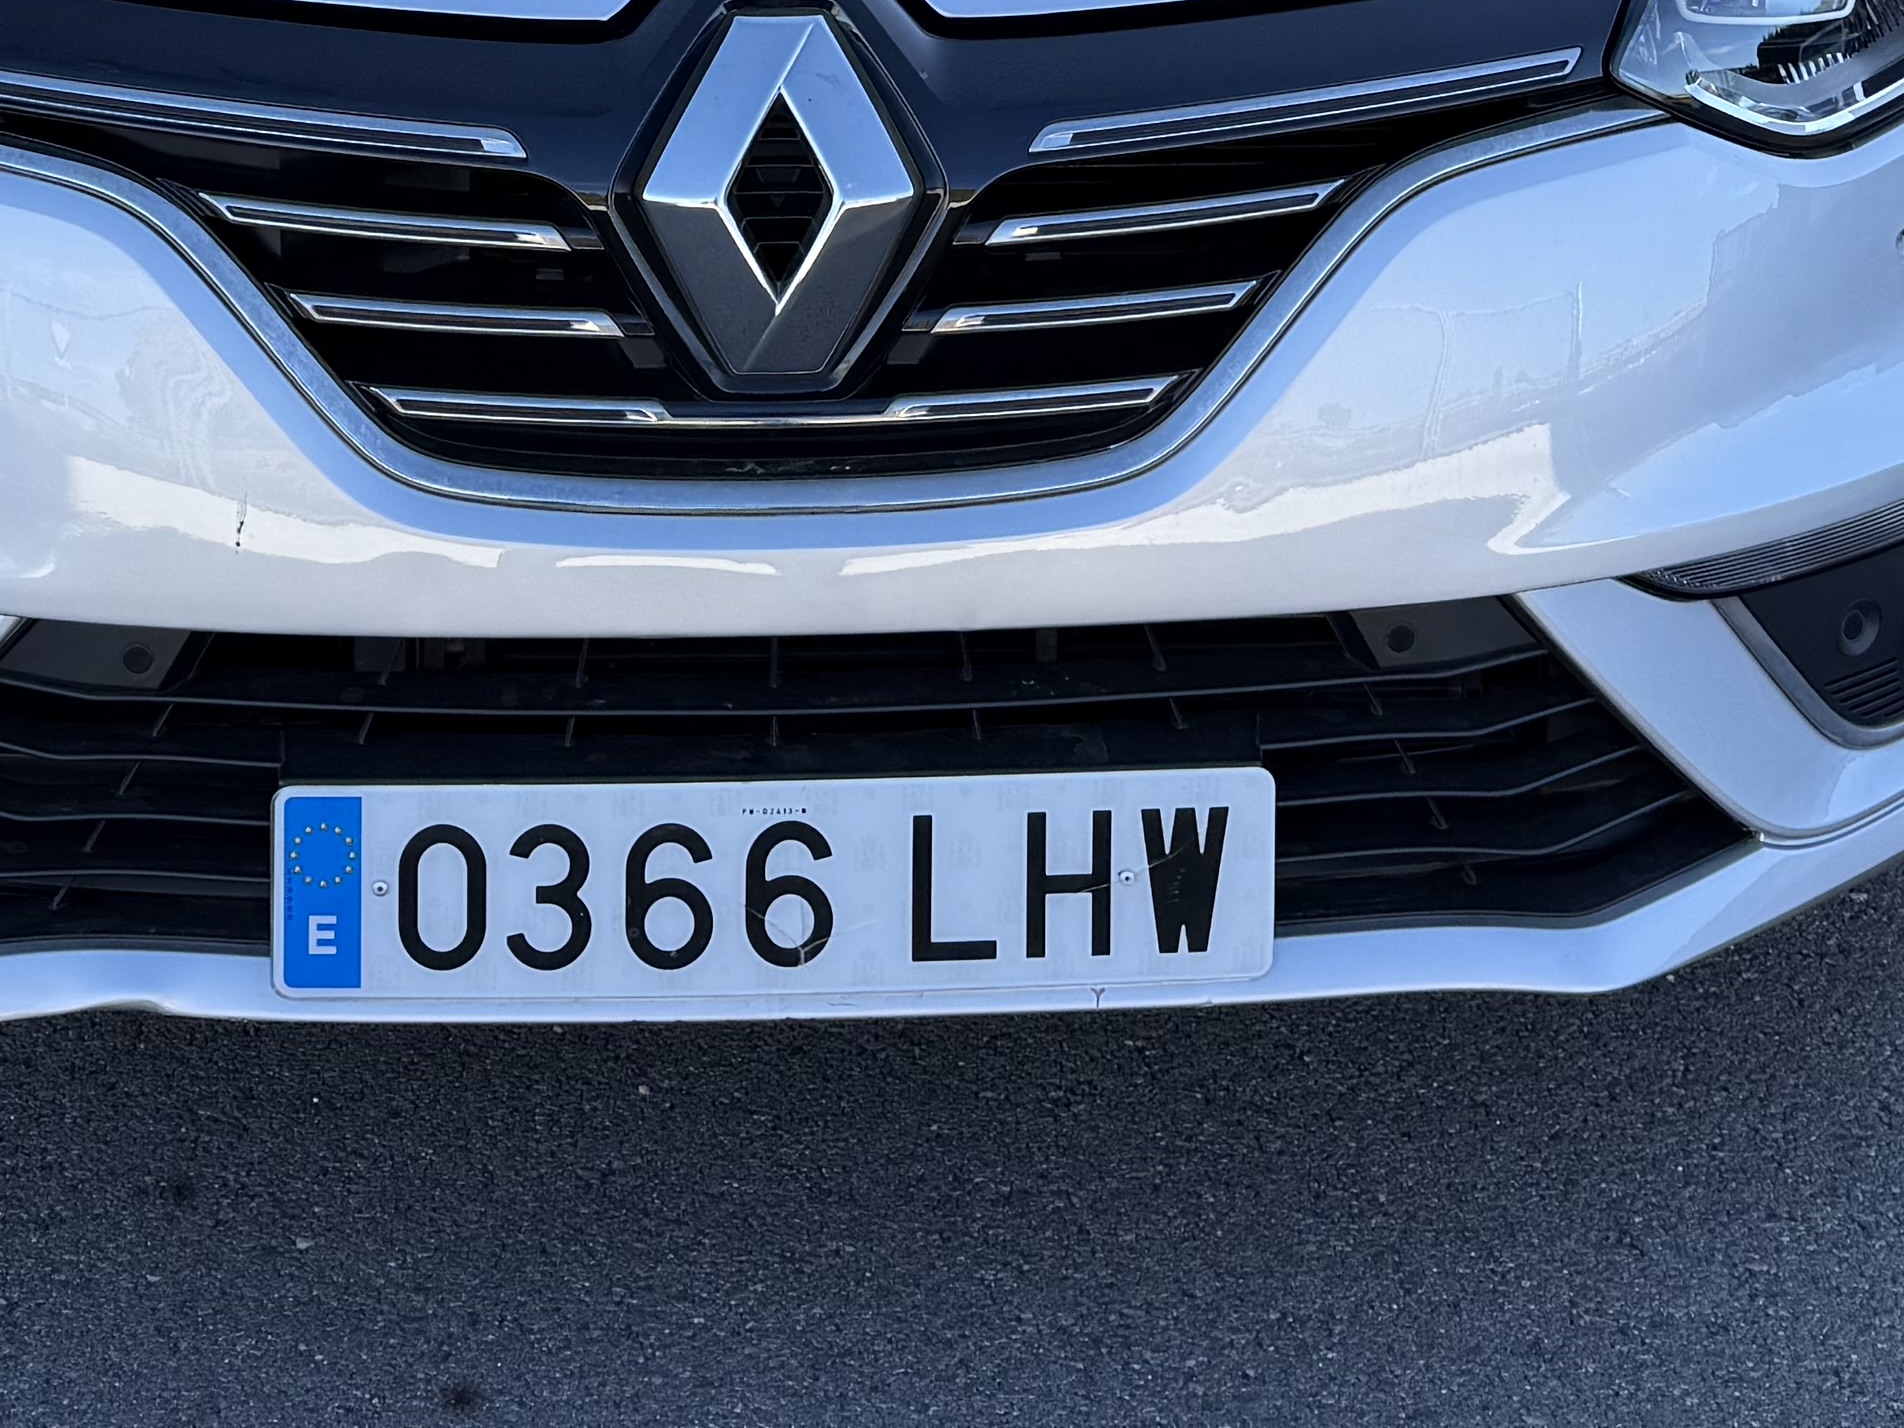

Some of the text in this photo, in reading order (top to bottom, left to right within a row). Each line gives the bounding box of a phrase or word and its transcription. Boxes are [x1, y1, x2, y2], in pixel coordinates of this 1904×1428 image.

[308, 915, 338, 955] E
[398, 806, 1230, 972] 0366 LHW
